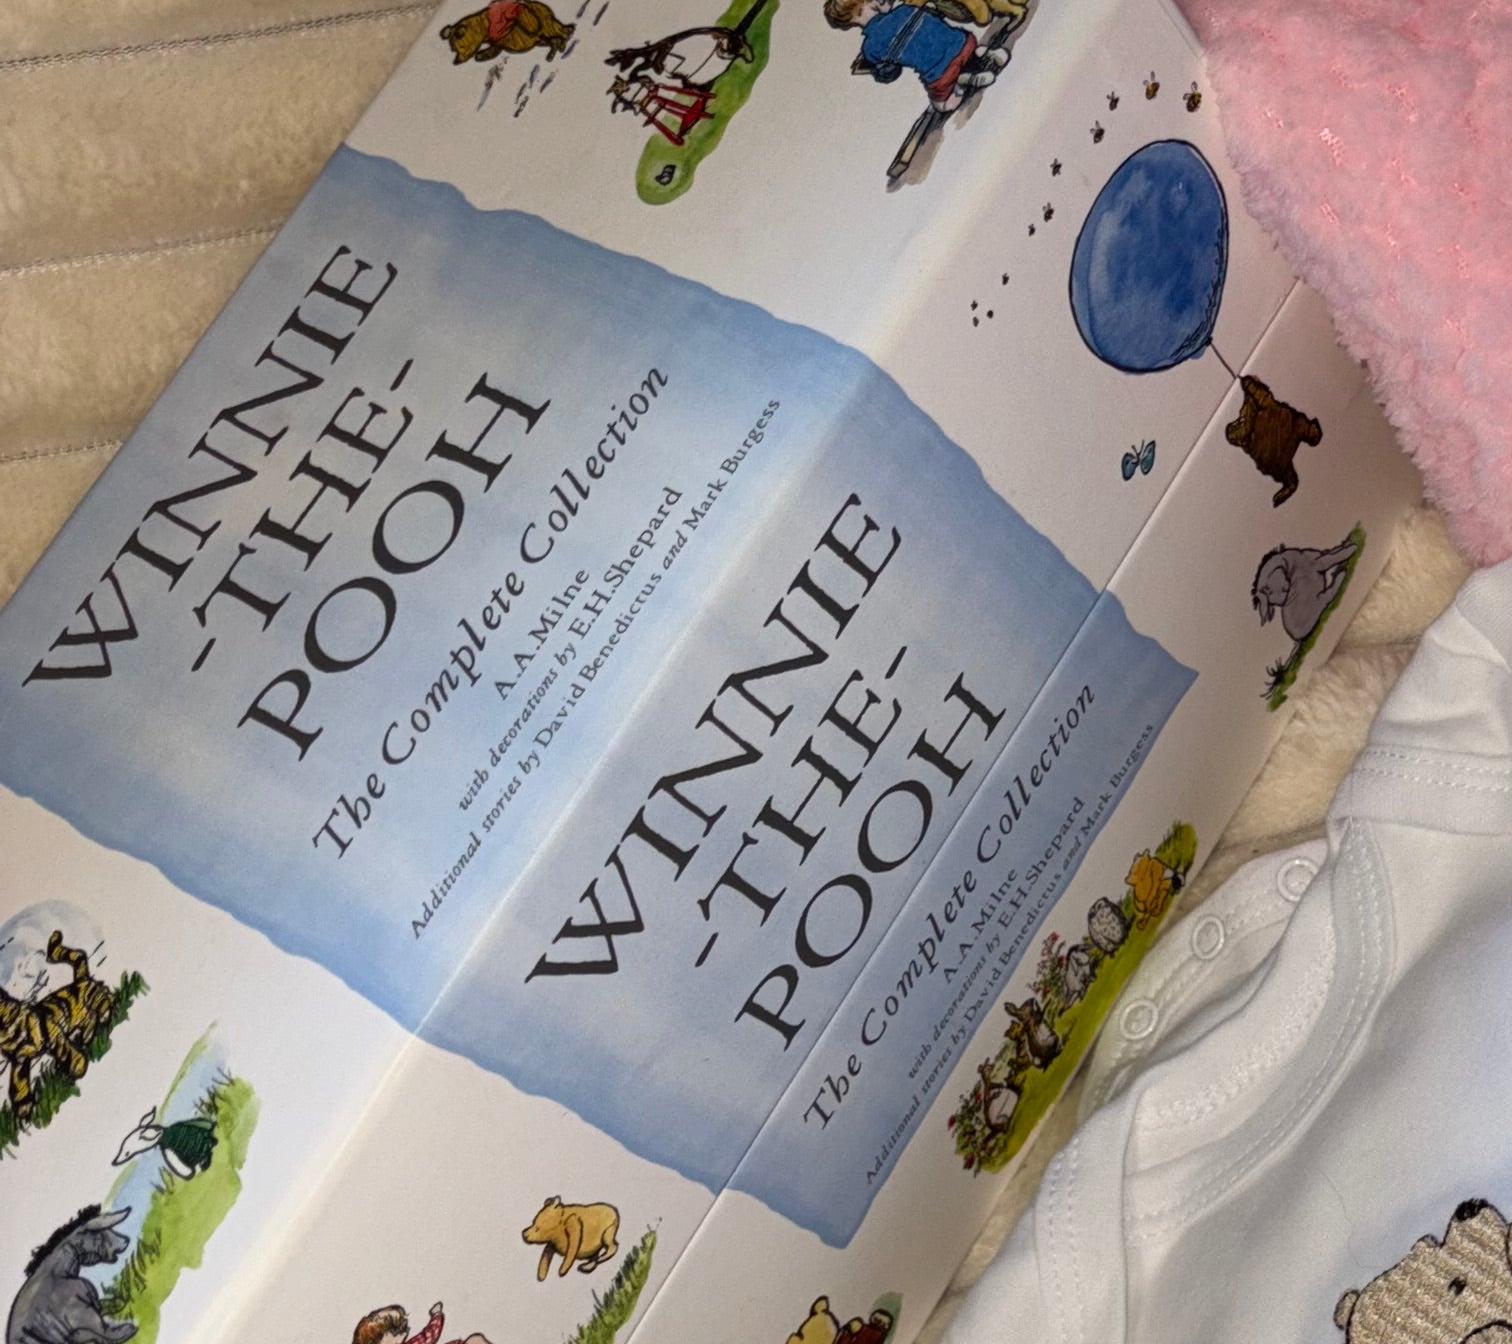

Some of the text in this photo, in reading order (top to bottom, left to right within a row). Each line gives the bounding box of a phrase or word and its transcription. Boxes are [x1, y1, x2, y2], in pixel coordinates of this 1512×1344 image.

[22, 245, 398, 687] WINNIE
[191, 358, 414, 672] -THE-
[237, 372, 552, 762] POOH
[312, 367, 669, 860] The Complete Collection
[411, 398, 781, 940] Additional stories by David Benedictus and Mark Burgess
[458, 769, 490, 811] with
[489, 670, 559, 768] decorations
[554, 641, 578, 667] by
[524, 492, 902, 984] WINNIE
[694, 645, 908, 968] -THE-
[733, 671, 1007, 1052] POOH
[802, 684, 1096, 1130] The Complete Collection
[866, 723, 1155, 1185] Additional stories by David Benedictus and Mark Burgess
[907, 1040, 933, 1080] with
[932, 952, 988, 1041] decorations
[985, 932, 1002, 954] by
